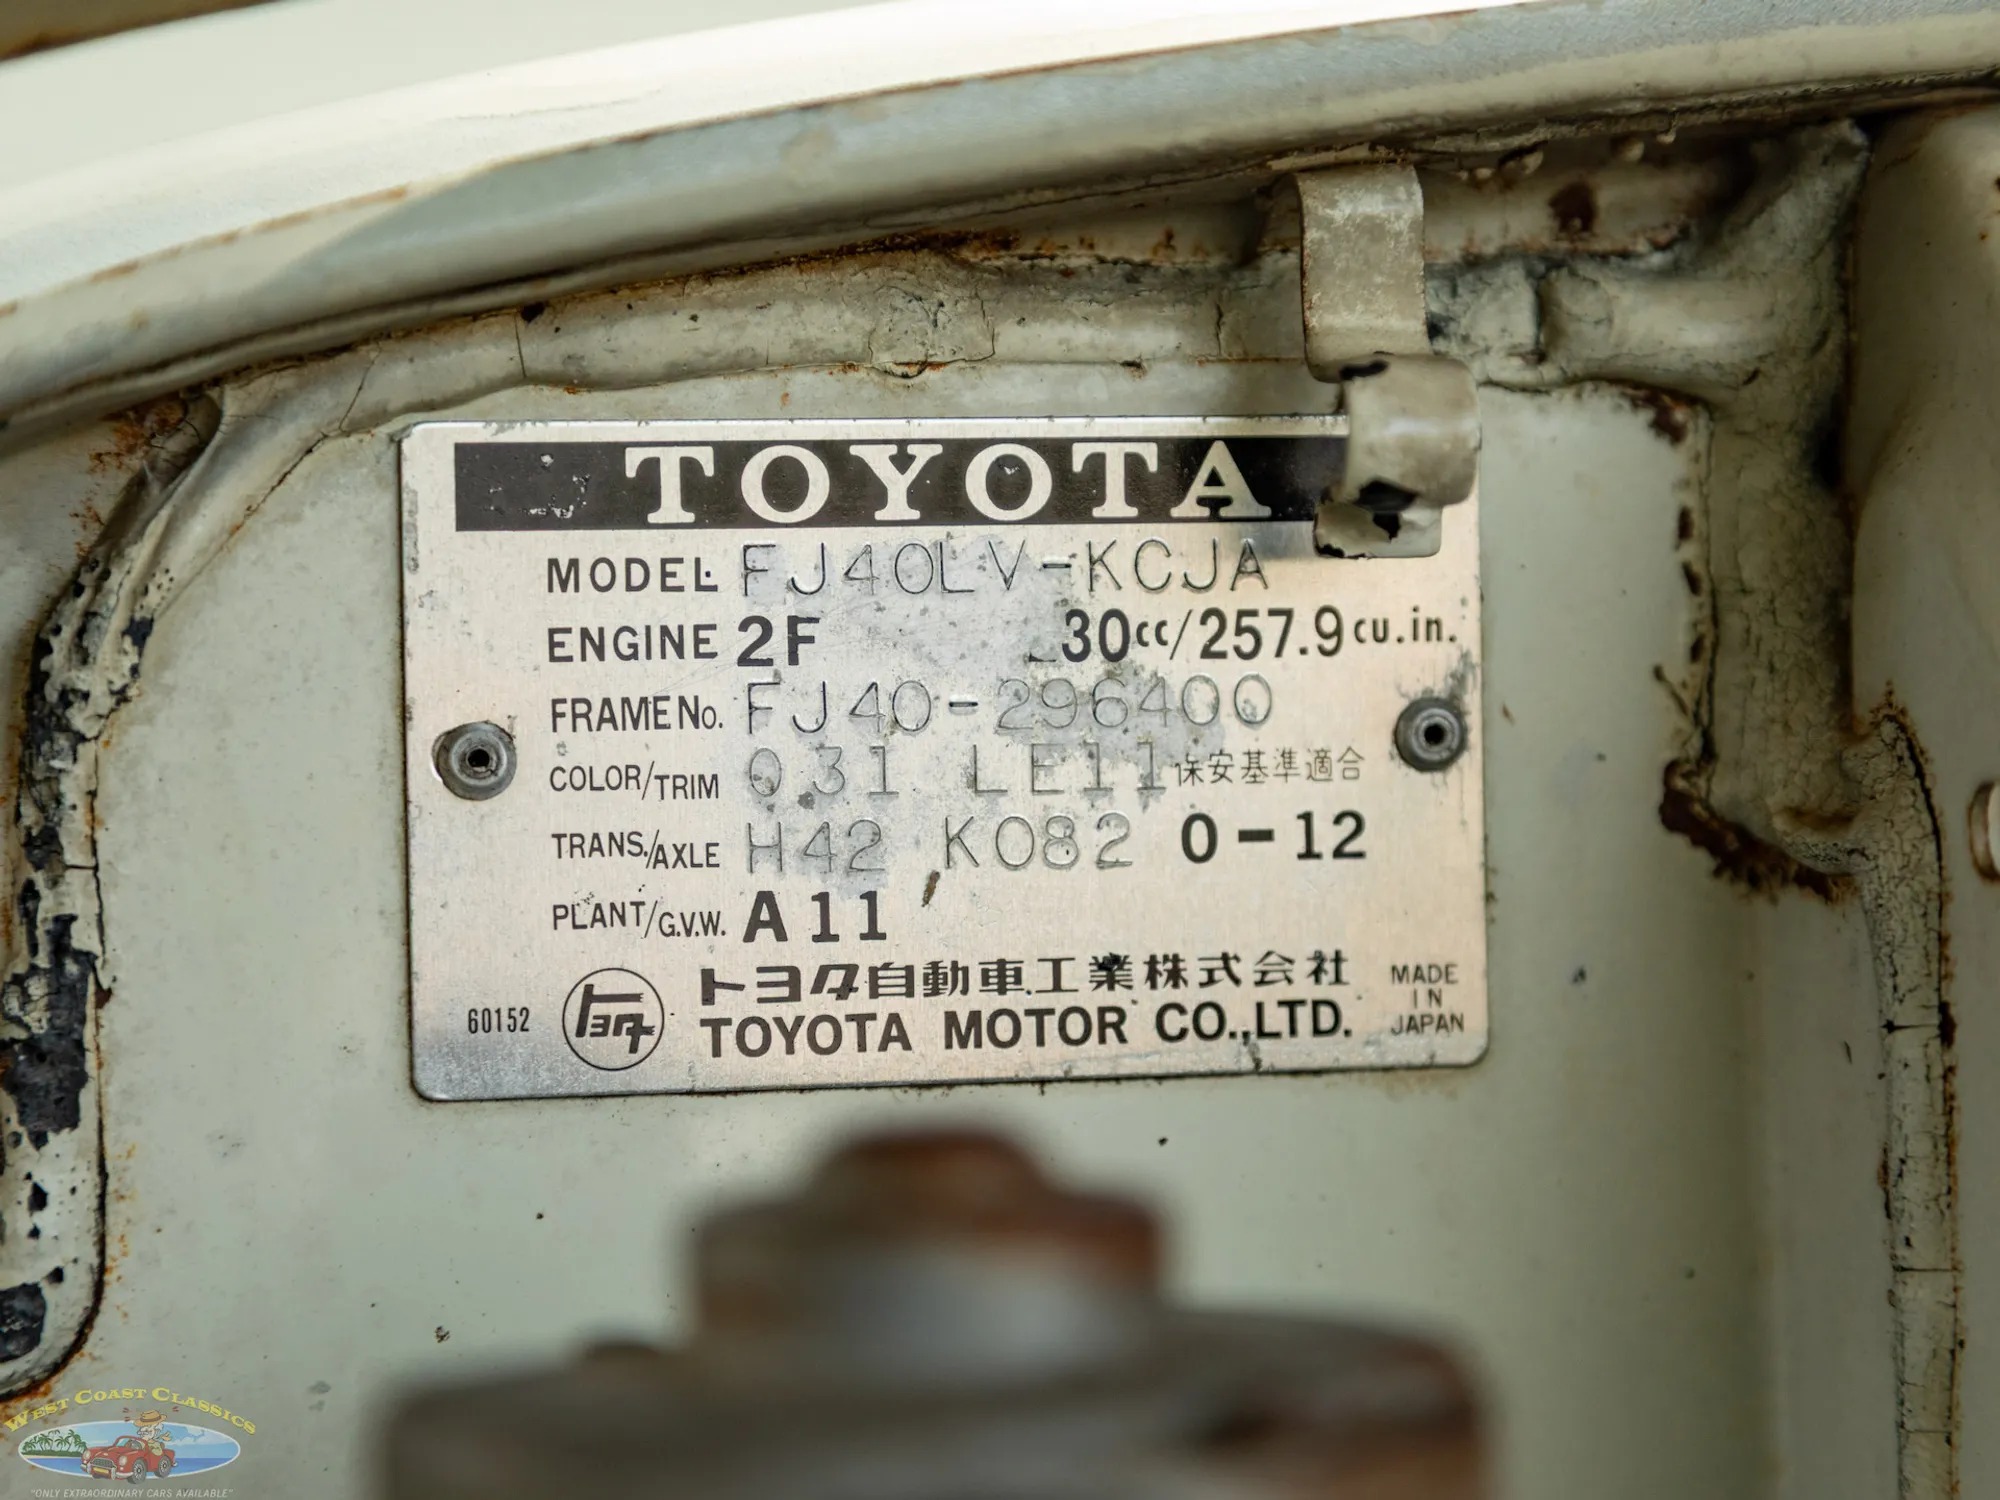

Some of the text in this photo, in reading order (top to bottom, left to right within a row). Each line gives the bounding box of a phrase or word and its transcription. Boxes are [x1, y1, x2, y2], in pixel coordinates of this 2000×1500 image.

[625, 440, 1272, 524] TOYOTA
[547, 537, 1270, 598] MODEL FJ40LV-KCJA
[548, 624, 718, 663] ENGINE
[737, 615, 821, 667] 2F
[1028, 605, 1344, 662] 30cc/257.9
[551, 673, 1272, 735] FRAME No. FJ40-296400
[550, 761, 719, 800] COLOR/TRIM
[748, 746, 900, 797] 031
[1174, 746, 1365, 787] 保安基準適合
[747, 819, 886, 874] H42
[701, 949, 1350, 1006] トヨタ自動車工業株式会社
[1391, 964, 1459, 986] MADE
[1413, 988, 1444, 1009] IN
[468, 1007, 530, 1034] 60152
[700, 1008, 913, 1058] TOYOTA
[943, 1003, 1128, 1050] MOTOR
[1391, 1013, 1465, 1036] JAPAN
